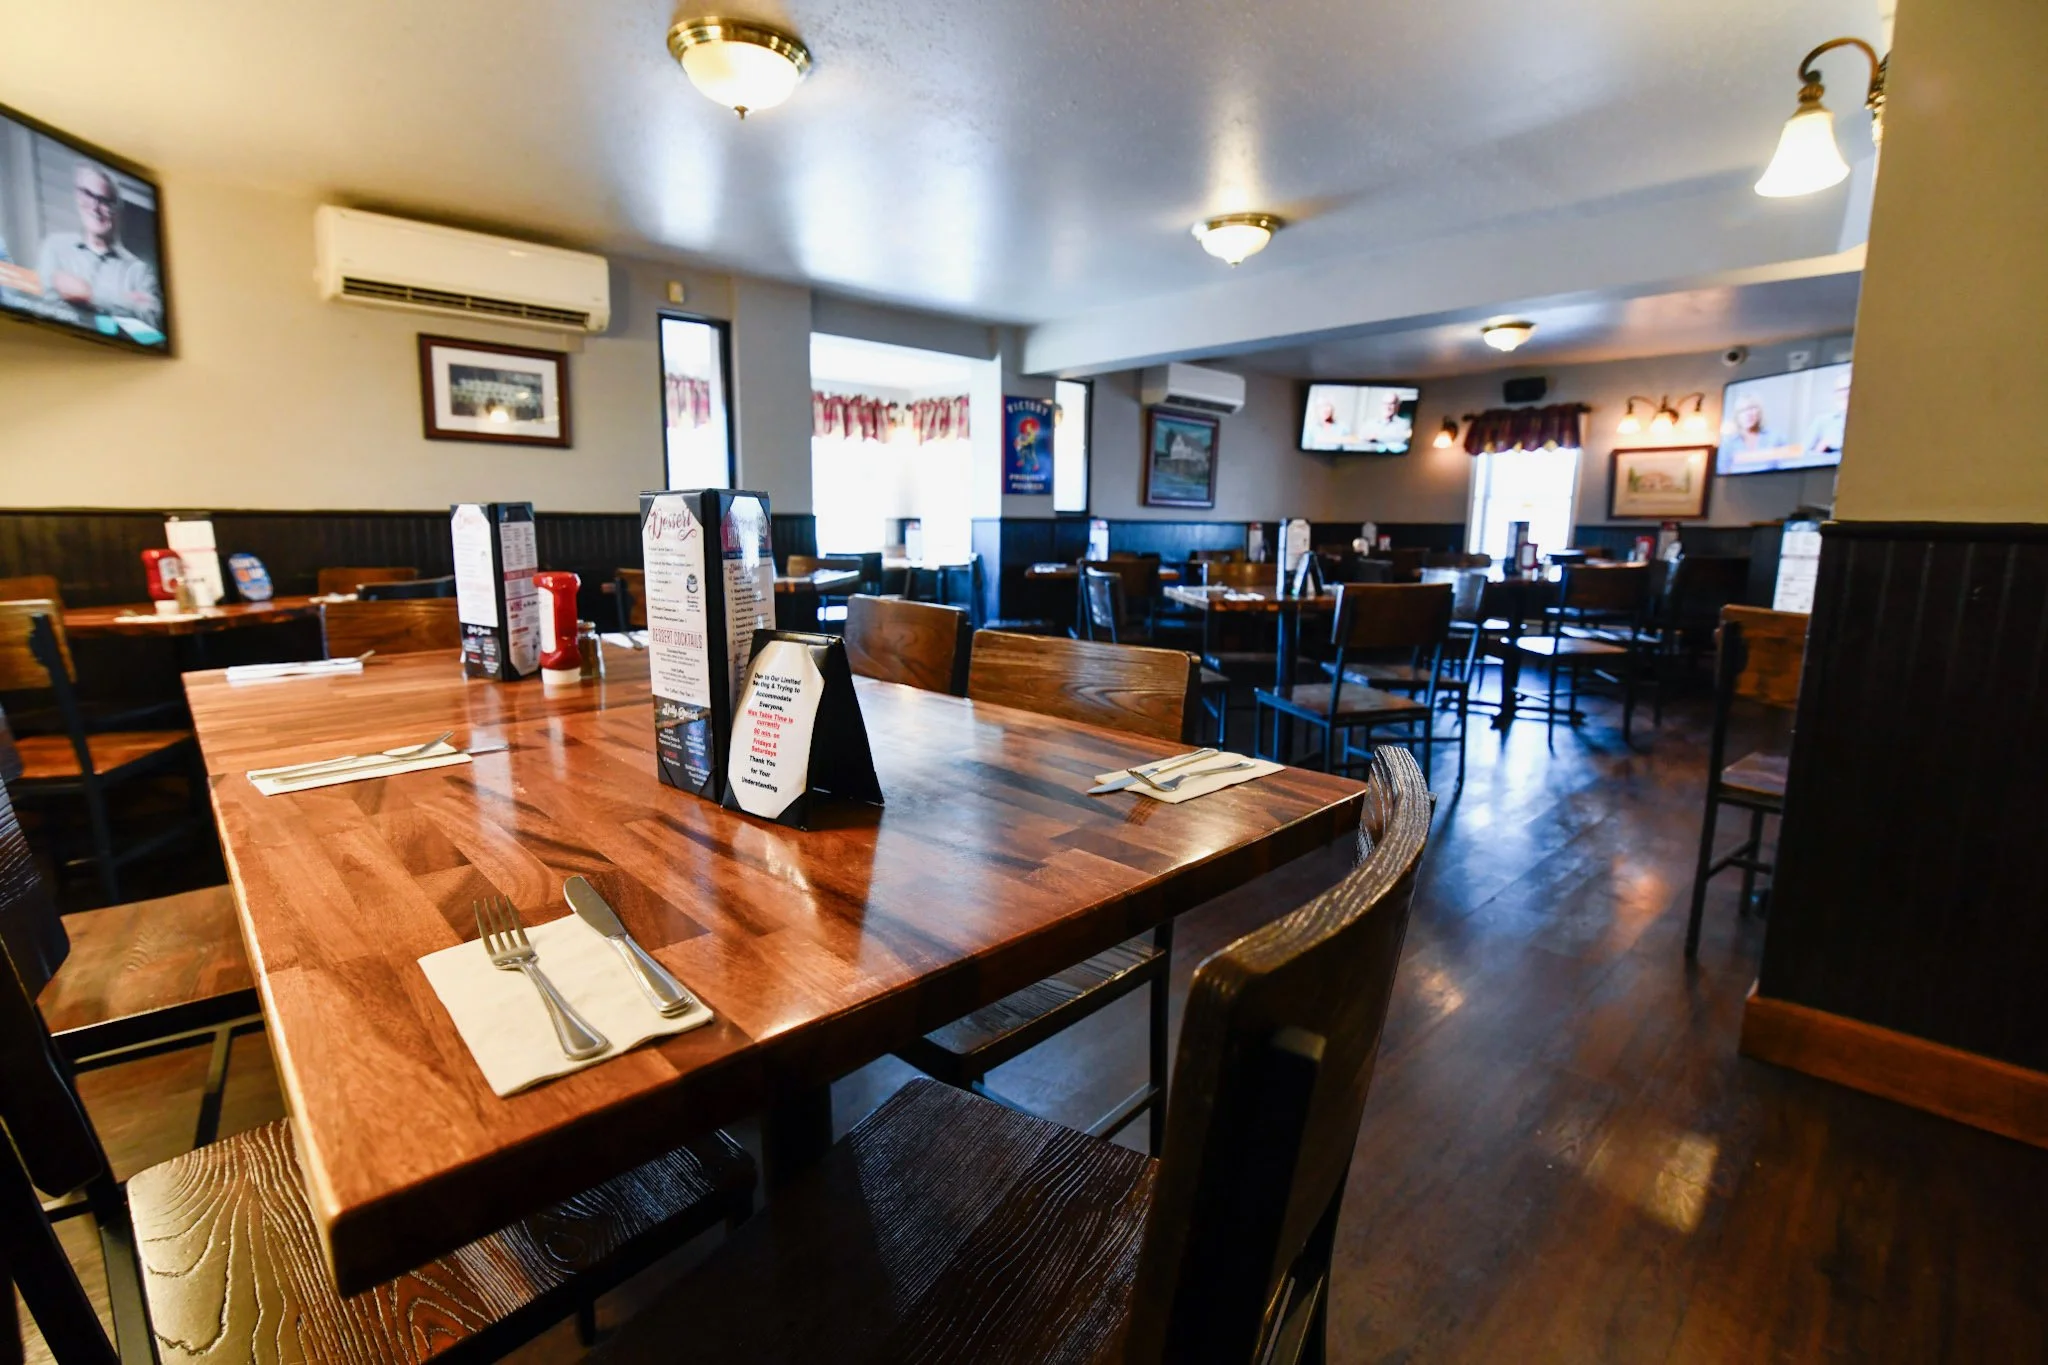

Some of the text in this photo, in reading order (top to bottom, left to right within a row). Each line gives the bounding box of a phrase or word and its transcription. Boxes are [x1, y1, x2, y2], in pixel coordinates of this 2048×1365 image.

[1007, 401, 1047, 416] VICTORY
[648, 508, 692, 540] Dessert
[652, 628, 703, 649] DESSERT COCKTAILS
[781, 676, 801, 685] Limited
[777, 683, 794, 693] Trying
[756, 691, 792, 702] Accommodate
[759, 701, 784, 712] Everyone,
[759, 711, 773, 719] Table
[774, 713, 788, 722] Time
[757, 720, 780, 729] currently
[753, 738, 771, 748] Fridays
[751, 745, 777, 757] Saturdays
[749, 755, 765, 765] Thank
[759, 769, 770, 777] Your
[742, 776, 778, 792] Understanding
